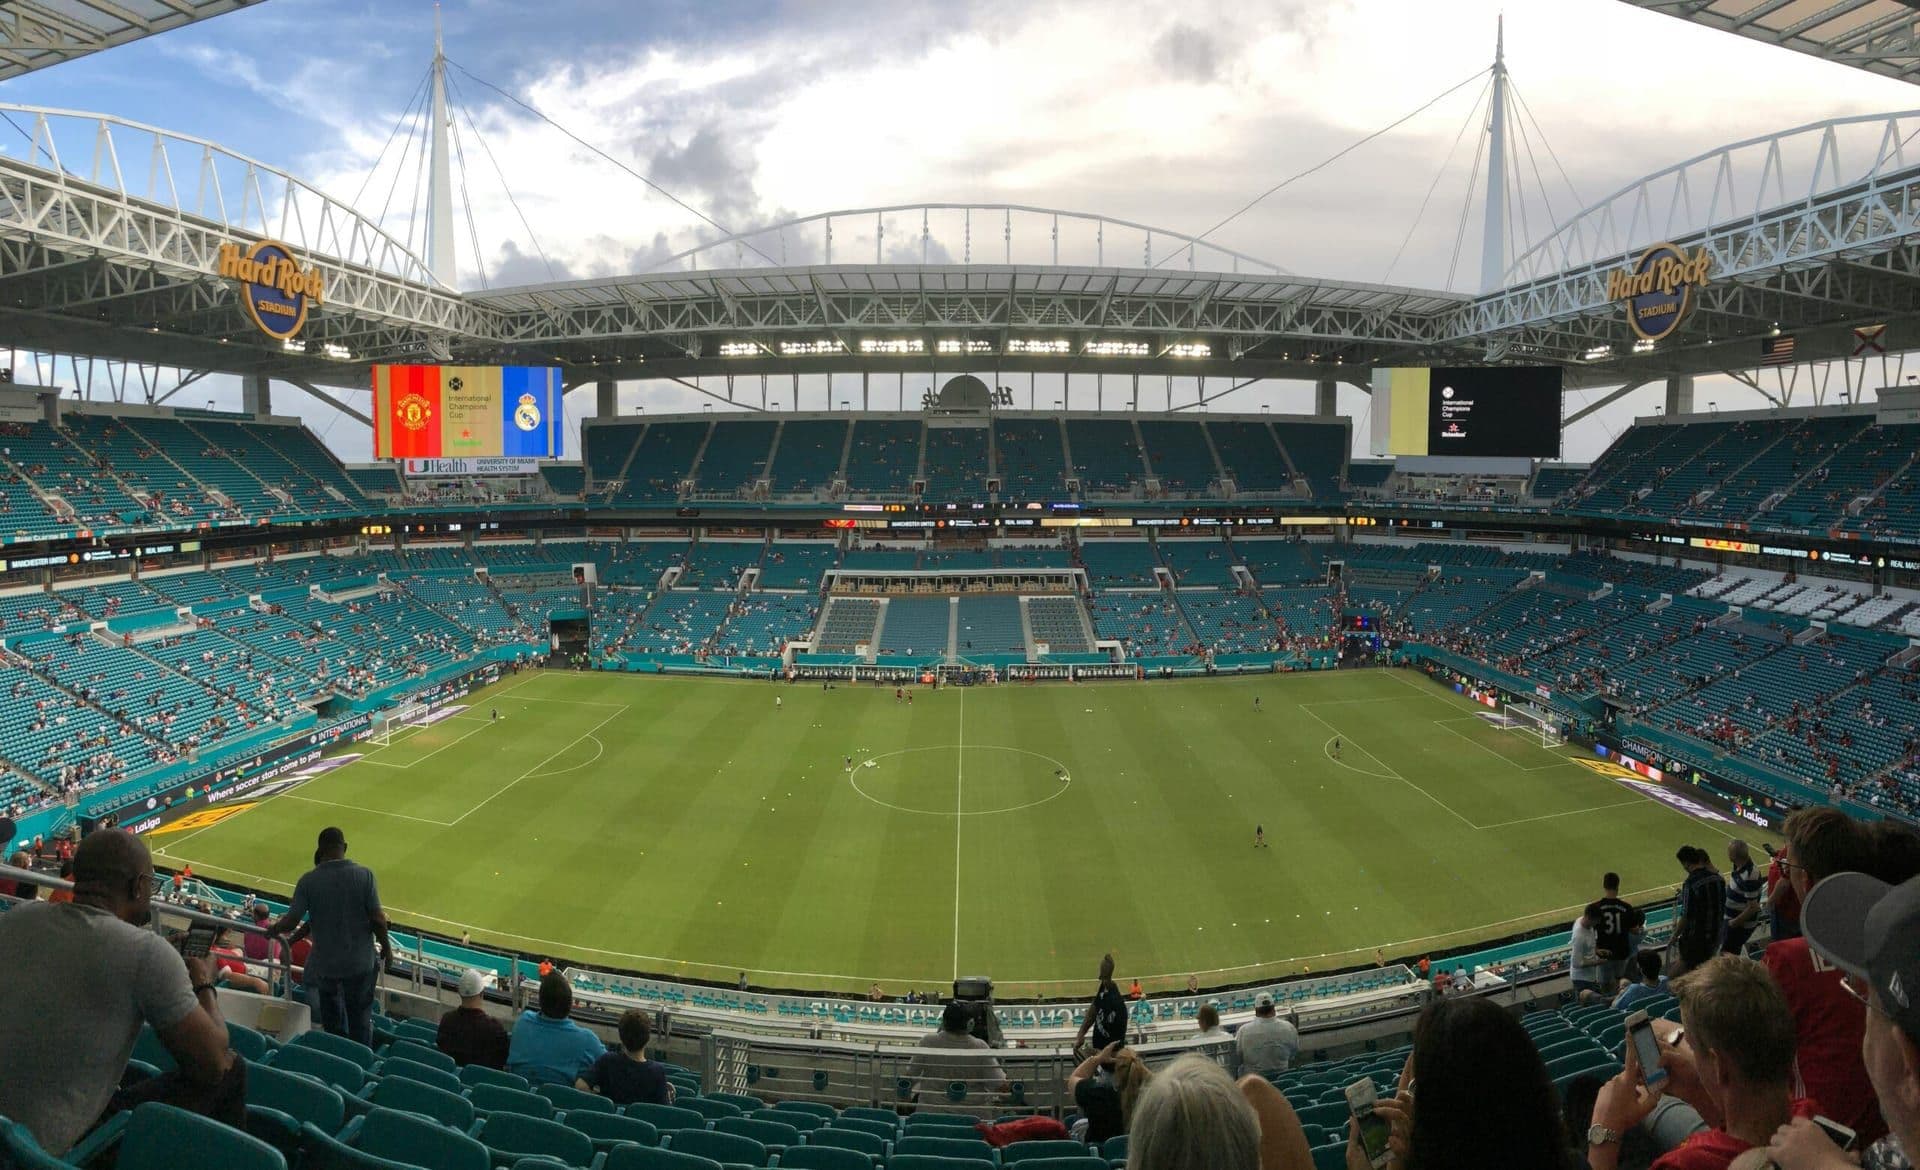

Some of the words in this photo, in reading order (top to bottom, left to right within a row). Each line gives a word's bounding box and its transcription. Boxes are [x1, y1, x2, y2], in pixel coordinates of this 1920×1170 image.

[219, 243, 277, 286] Hard
[276, 259, 324, 305] Rock
[1608, 260, 1656, 300] Hard
[1658, 247, 1711, 296] Rock
[258, 300, 297, 317] STADIUM
[1638, 302, 1678, 319] STADIUM
[448, 403, 488, 411] Champions
[448, 411, 464, 419] Cup
[476, 465, 498, 473] HEALTH
[1890, 559, 1905, 568] REAL
[207, 787, 234, 803] Where
[235, 775, 260, 792] soccer
[261, 768, 279, 781] stars
[280, 760, 299, 773] come
[299, 755, 307, 765] to
[308, 749, 322, 763] play
[134, 817, 161, 834] LaLiga
[1743, 809, 1769, 828] LaLiga
[1604, 911, 1621, 934] 31
